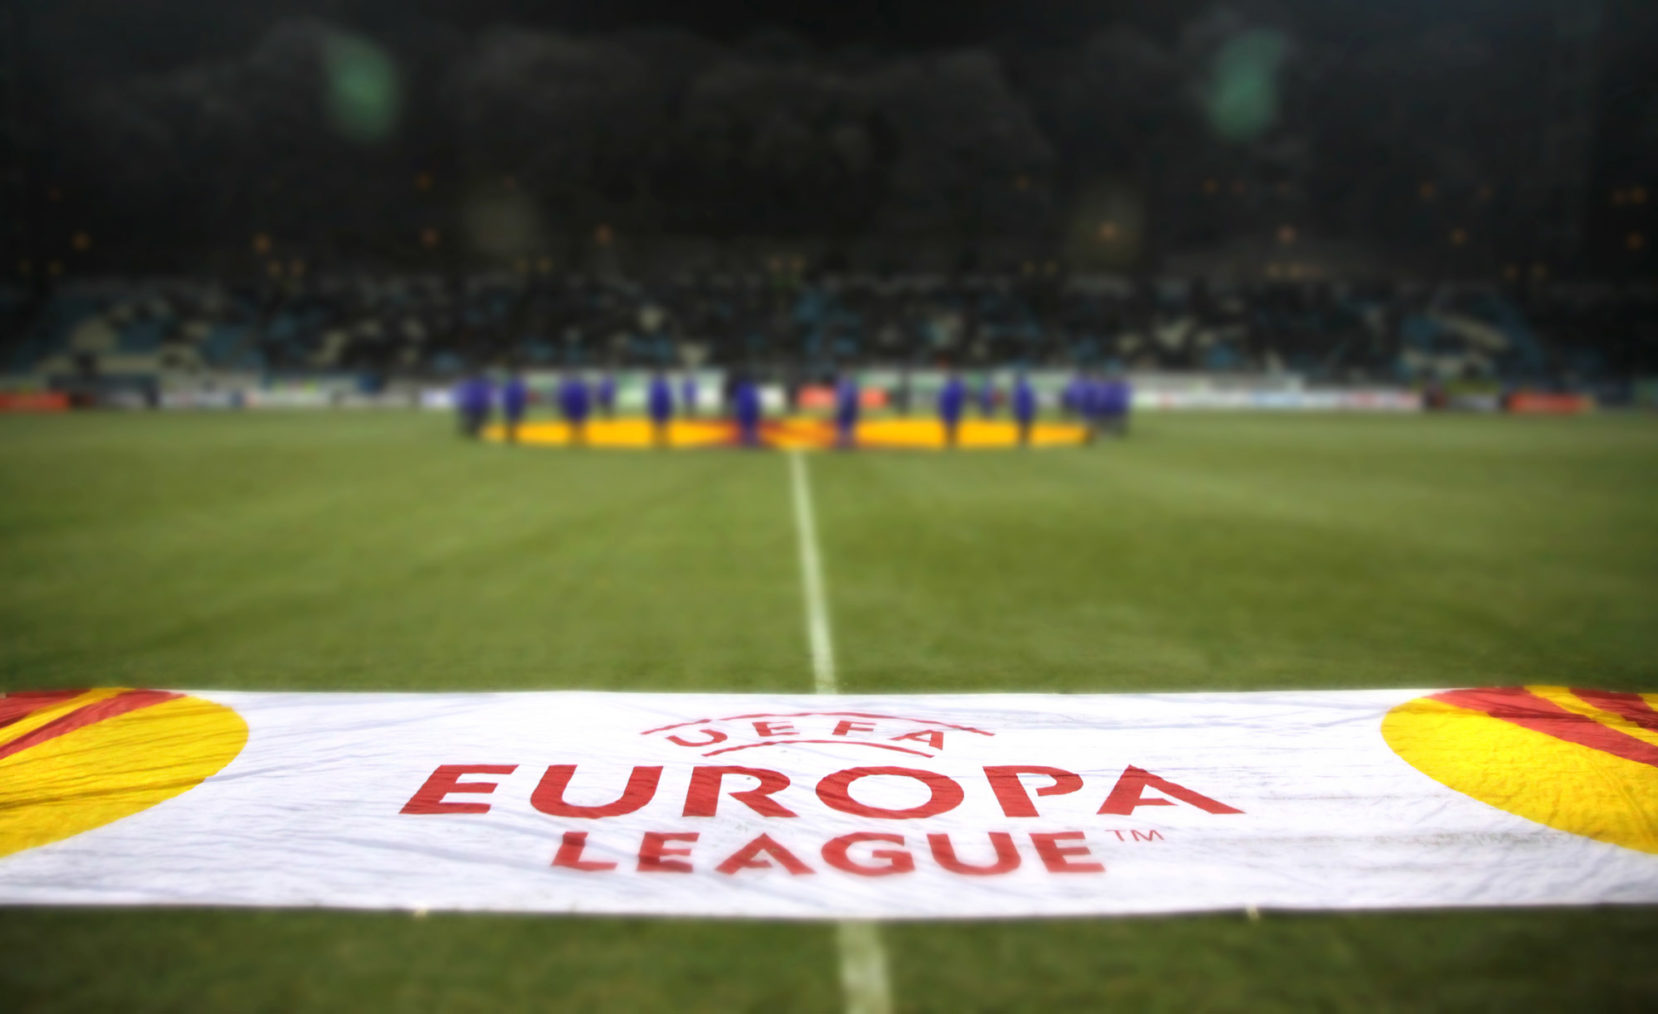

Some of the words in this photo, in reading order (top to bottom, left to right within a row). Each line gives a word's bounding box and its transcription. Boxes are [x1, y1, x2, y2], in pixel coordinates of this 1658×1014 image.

[665, 719, 945, 751] UEFA
[399, 763, 1244, 820] EUROPA
[551, 830, 1105, 878] LEAGUE
[1104, 829, 1165, 842] TM
